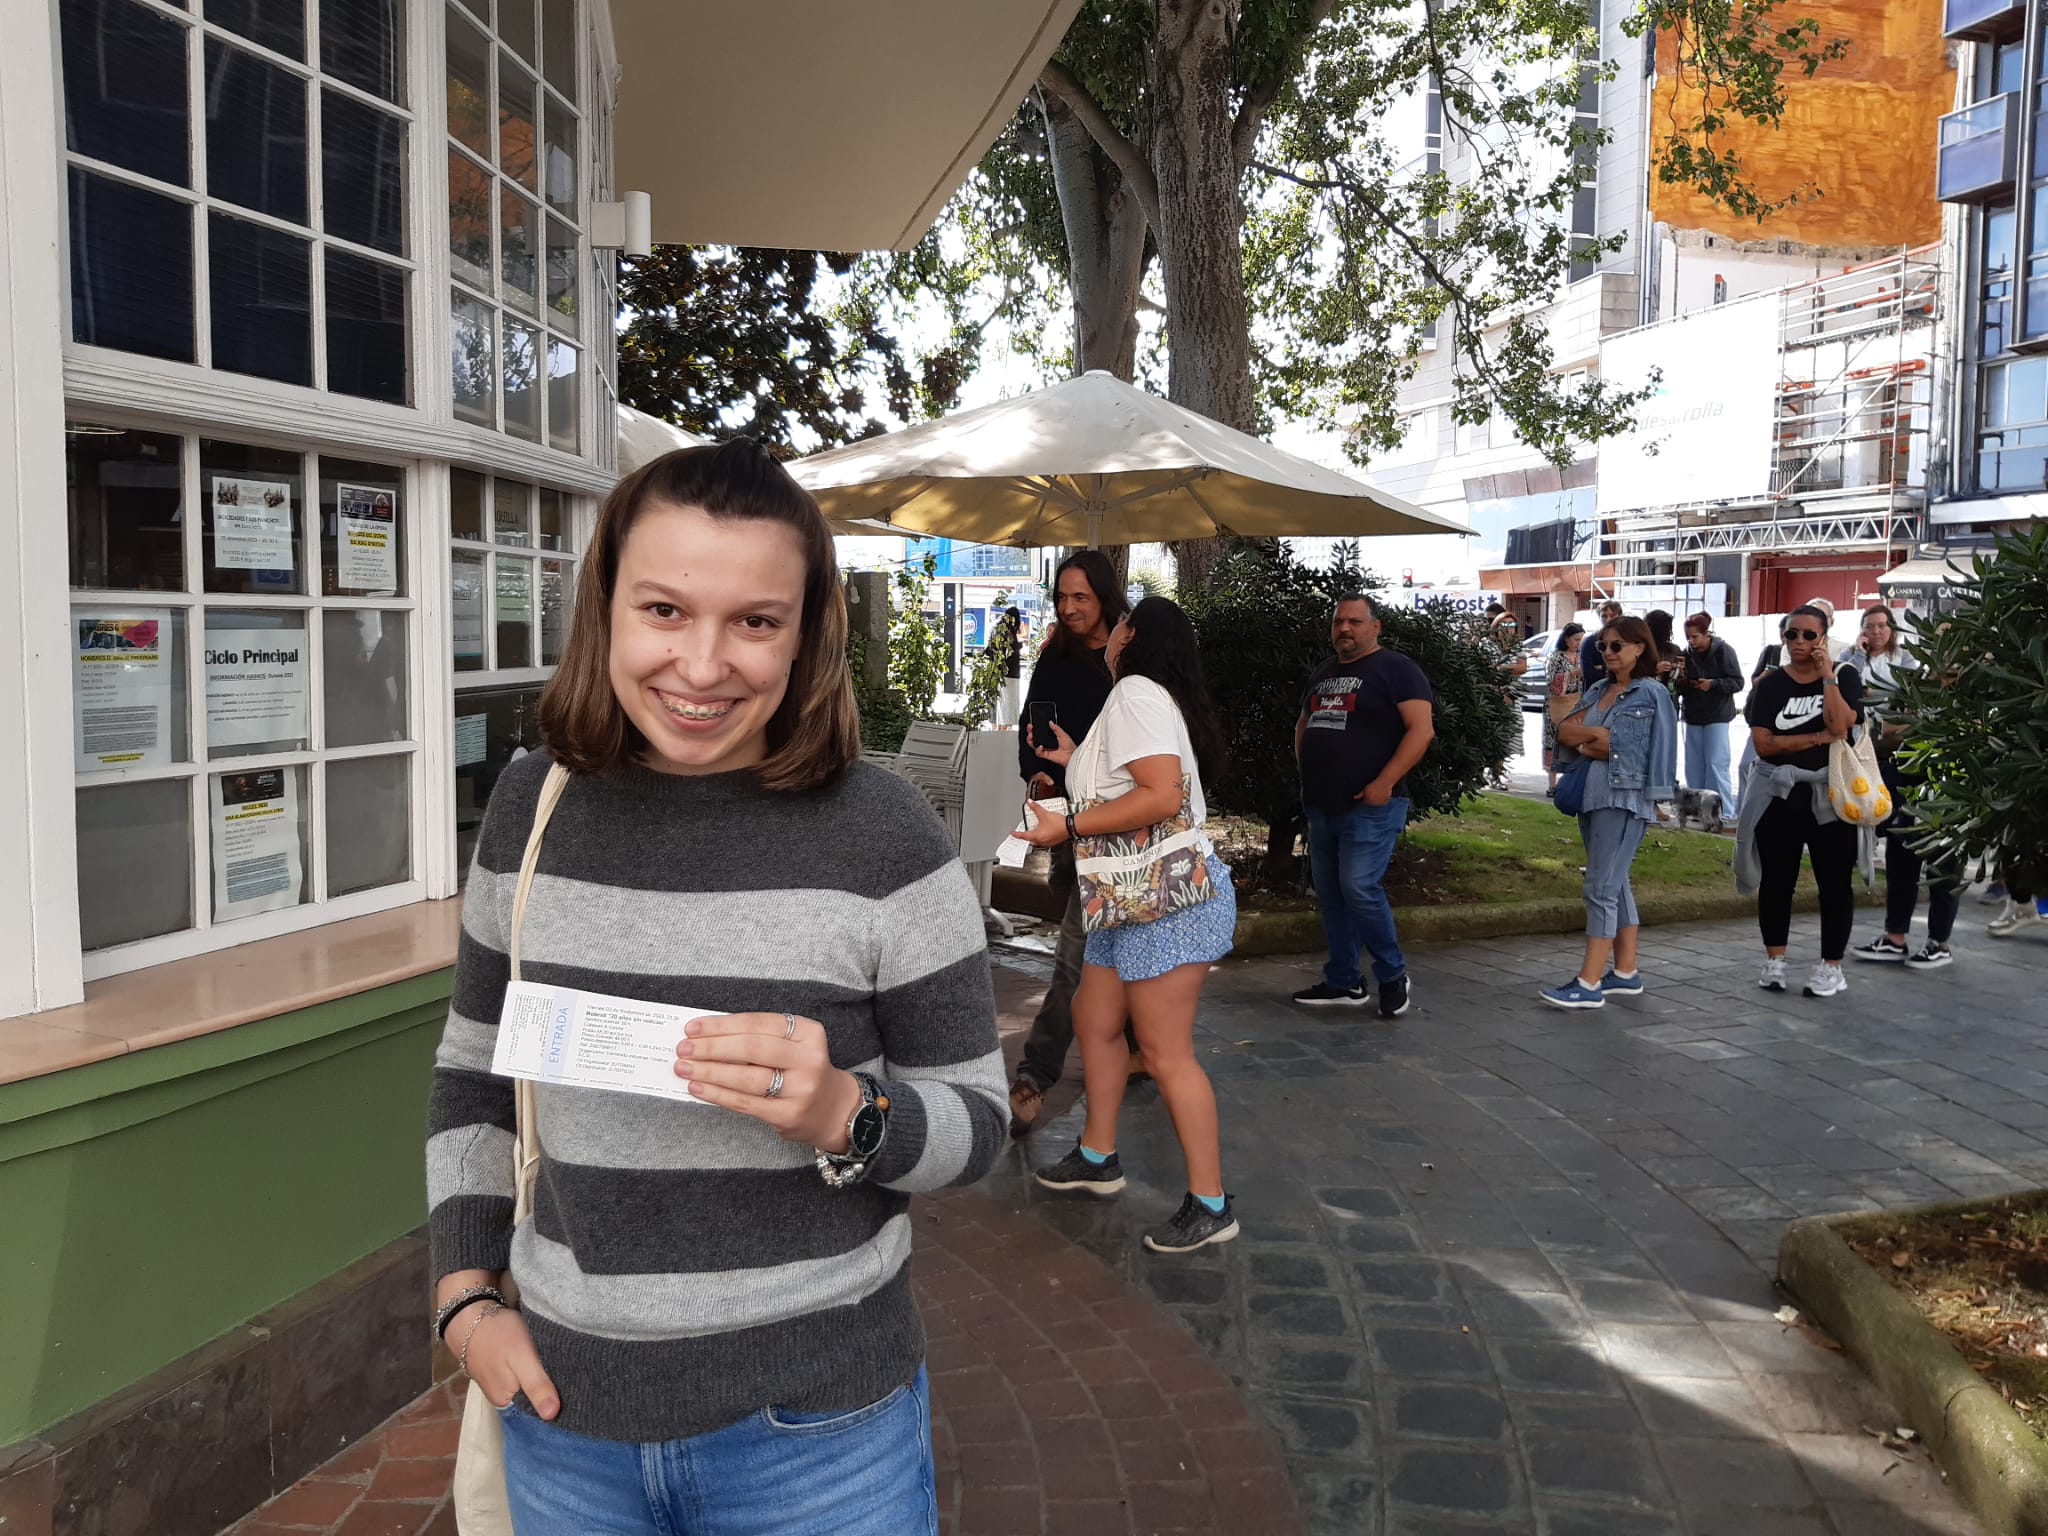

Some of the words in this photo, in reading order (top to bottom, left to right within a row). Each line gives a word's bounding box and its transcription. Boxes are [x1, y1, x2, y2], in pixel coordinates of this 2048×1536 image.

[205, 648, 239, 665] Ciclo
[242, 647, 299, 666] Principal
[1783, 694, 1825, 716] NIKE
[548, 1006, 569, 1064] ENTRADA
